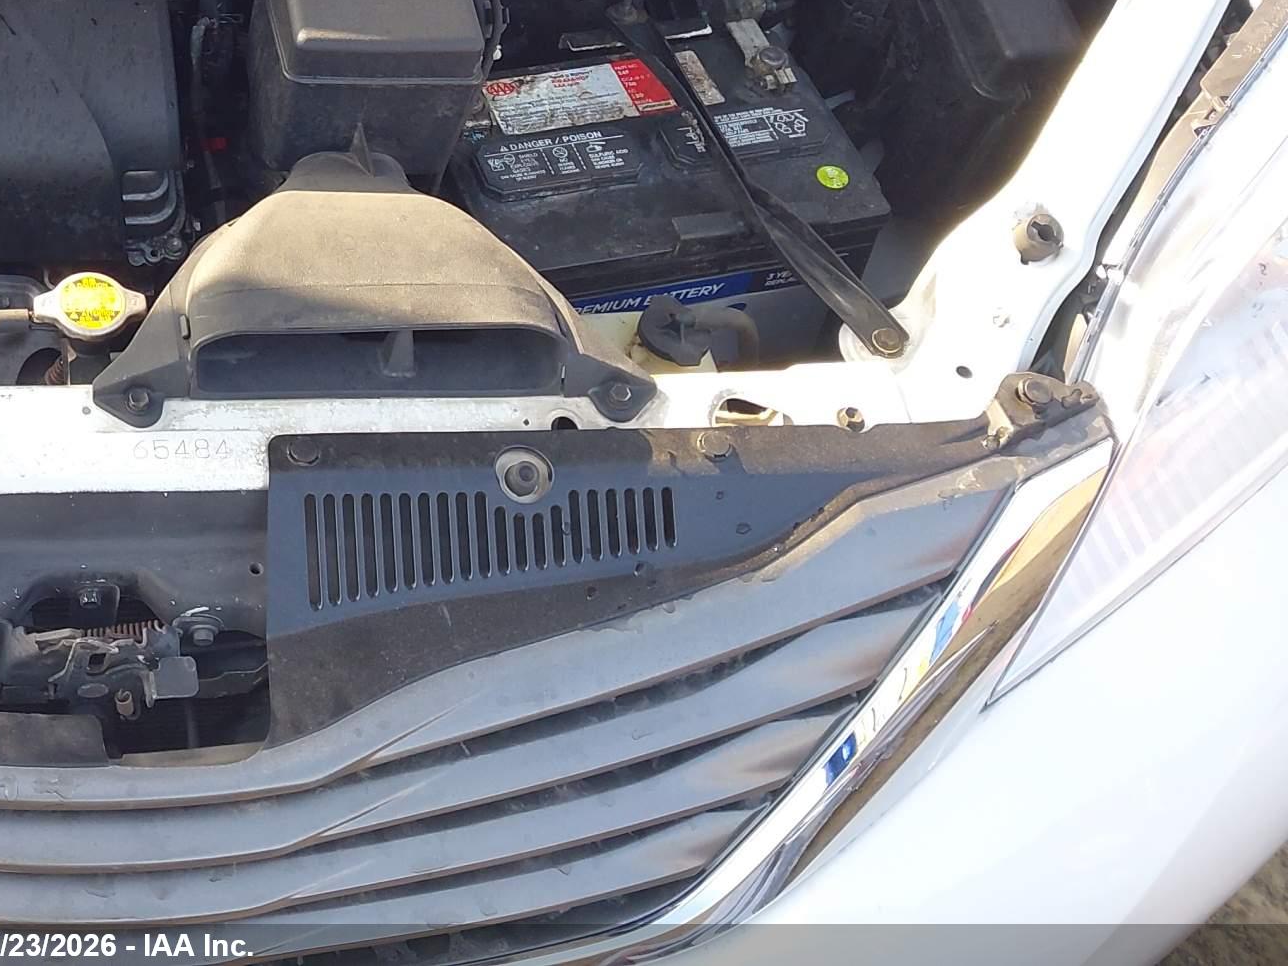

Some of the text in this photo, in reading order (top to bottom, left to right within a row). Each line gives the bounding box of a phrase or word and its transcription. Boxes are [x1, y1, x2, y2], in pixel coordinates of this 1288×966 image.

[510, 138, 553, 152] DANGER
[562, 131, 602, 143] POISON
[574, 283, 726, 313] EMIUM BTTERY
[133, 438, 232, 460] 65484
